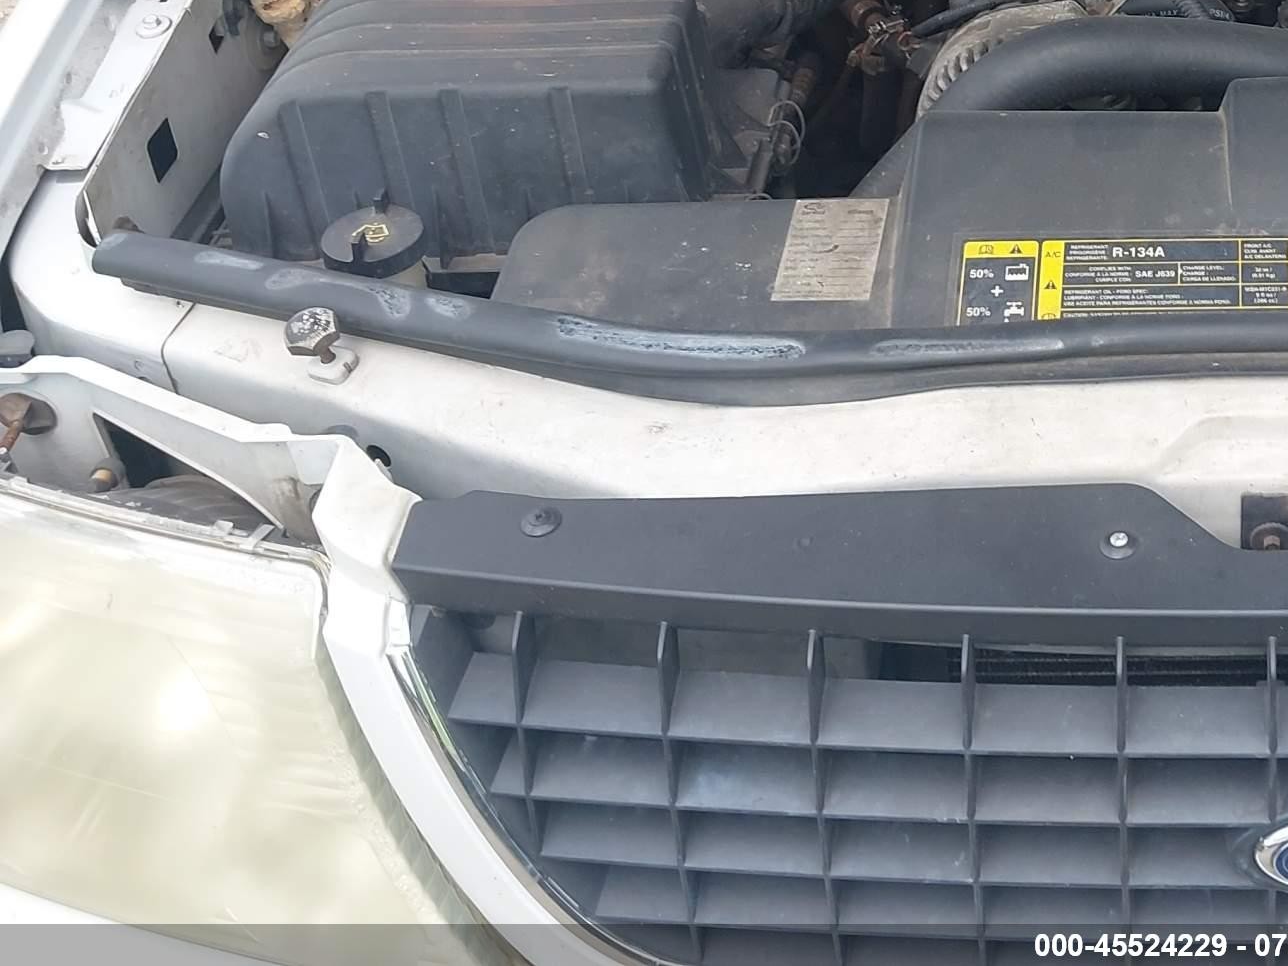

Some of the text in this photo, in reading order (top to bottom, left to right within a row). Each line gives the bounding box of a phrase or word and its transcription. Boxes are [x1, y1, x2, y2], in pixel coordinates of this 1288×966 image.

[1112, 246, 1165, 258] R-134A
[969, 268, 994, 279] 50%
[1135, 270, 1153, 278] SAE
[966, 306, 991, 317] 50%
